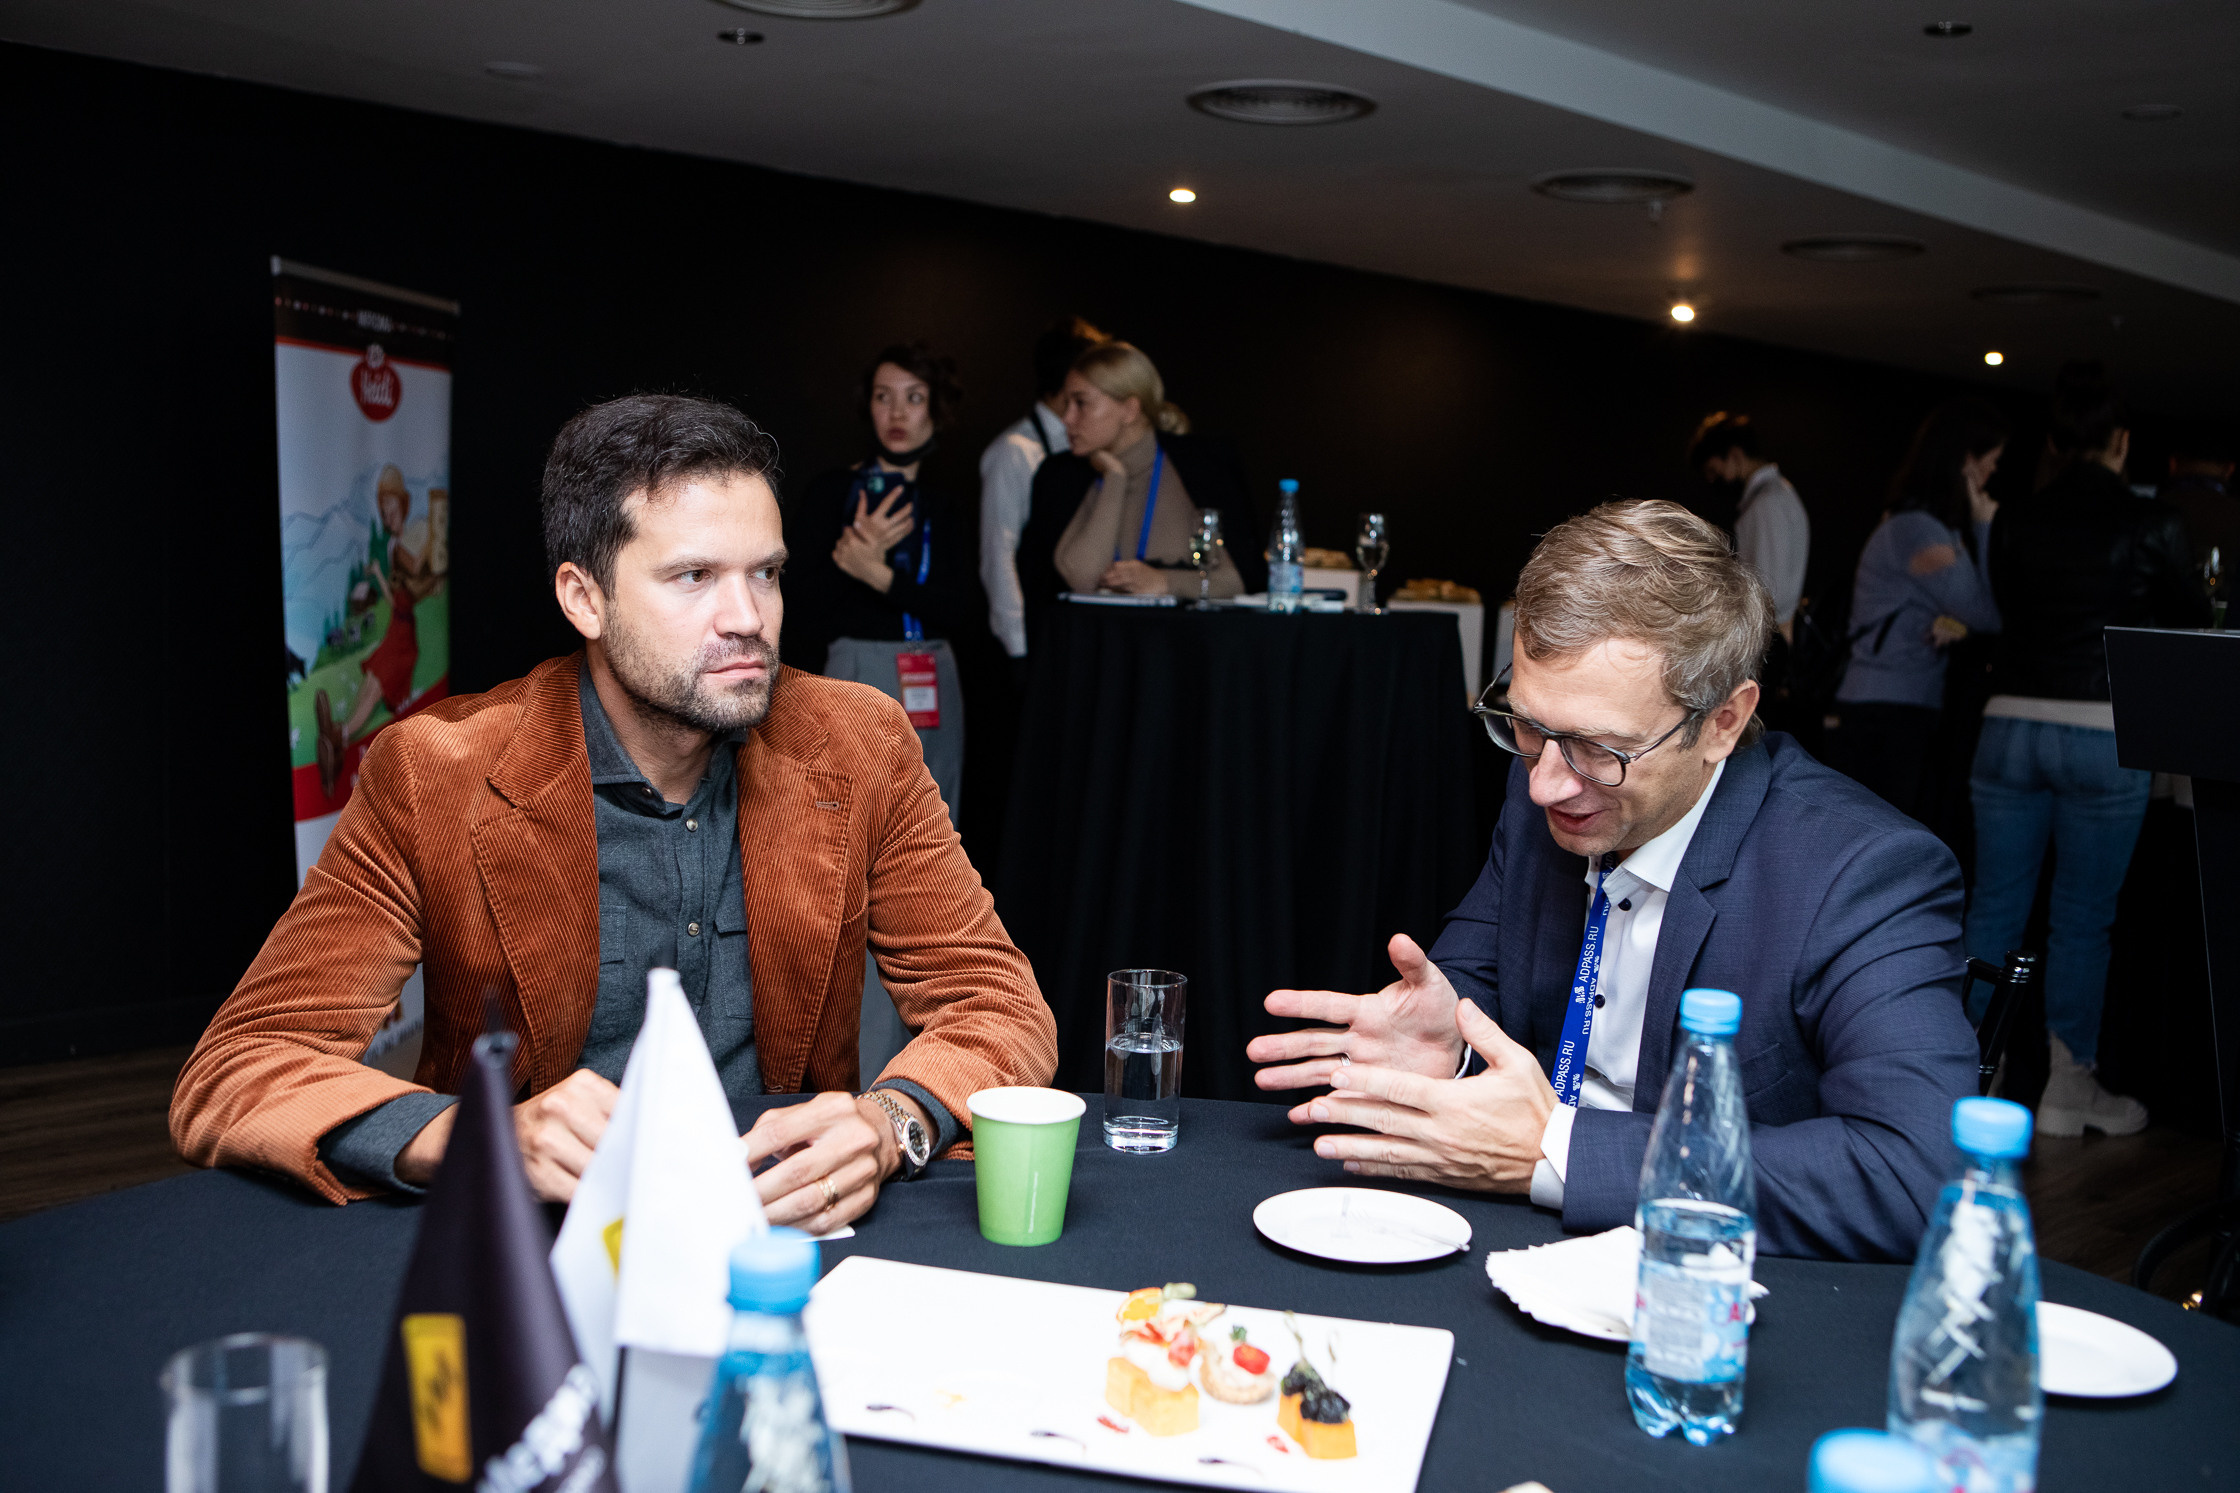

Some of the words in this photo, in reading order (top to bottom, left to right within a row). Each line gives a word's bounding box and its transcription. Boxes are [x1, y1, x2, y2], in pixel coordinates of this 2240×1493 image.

[1578, 925, 1599, 983] ADPASS.RU
[1581, 977, 1597, 1035] ADPASS.RU
[1554, 1040, 1575, 1097] ADPASS.RU
